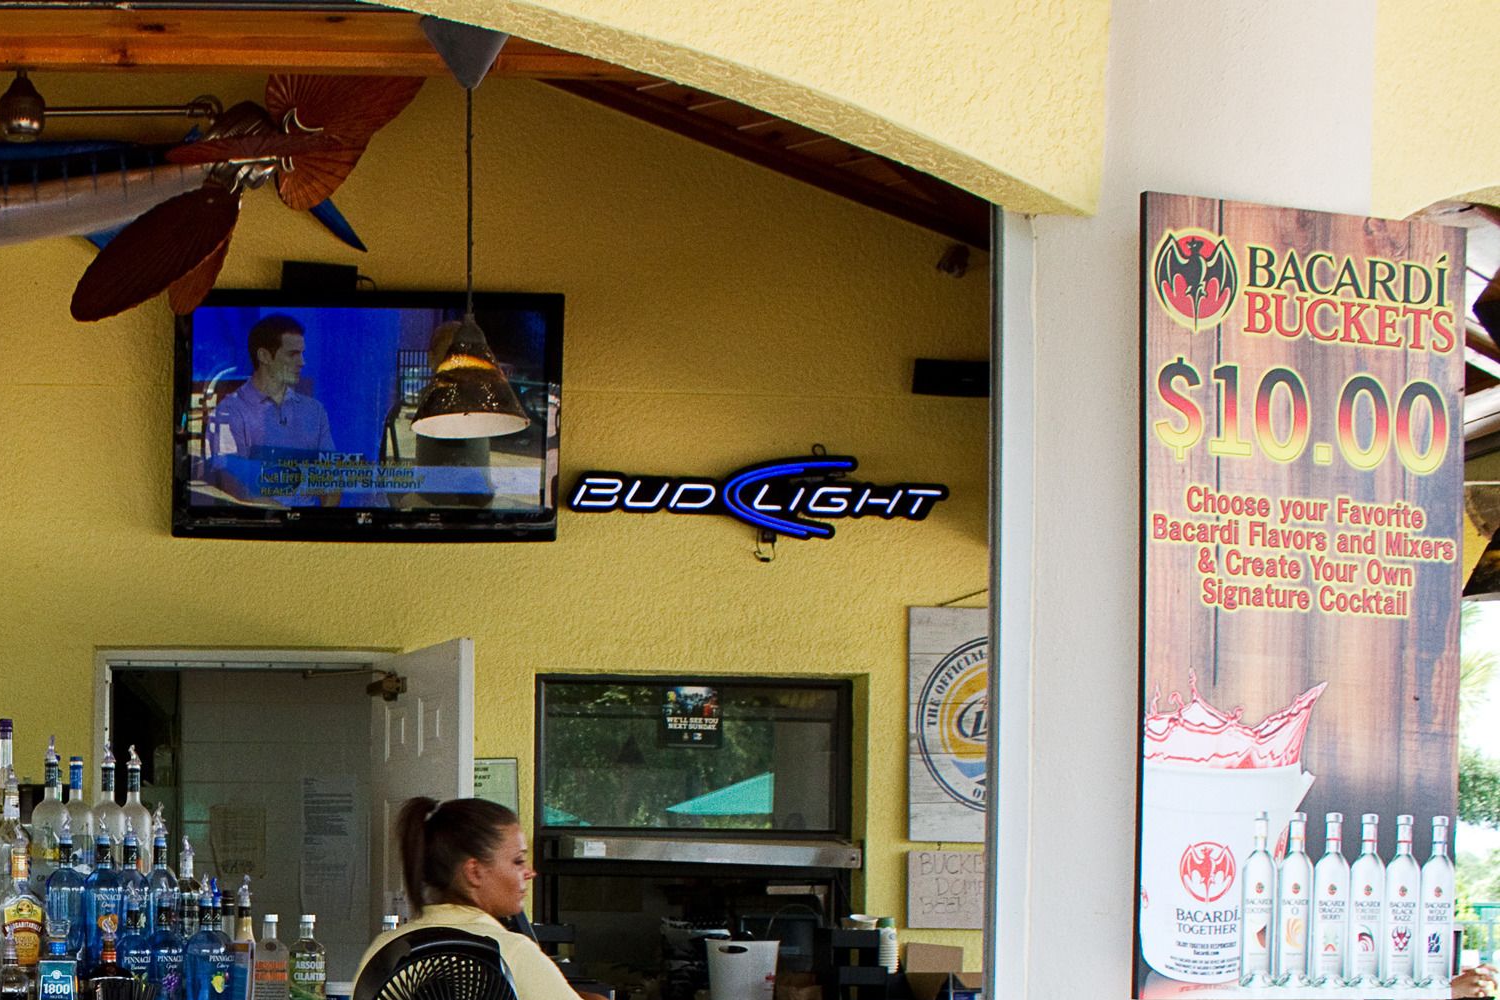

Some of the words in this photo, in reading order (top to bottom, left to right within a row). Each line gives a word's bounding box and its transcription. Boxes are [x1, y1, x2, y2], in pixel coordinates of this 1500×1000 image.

[1246, 246, 1449, 308] BACARDÍ
[1243, 290, 1455, 353] BUCKETS
[1155, 357, 1450, 475] $10.00
[572, 478, 716, 509] BUD
[752, 484, 943, 515] LIGHT
[1186, 485, 1270, 518] Choose
[1279, 498, 1329, 524] your
[1336, 498, 1424, 530] Favorite
[1152, 514, 1240, 545] Bacardi
[1249, 521, 1327, 552] Flavors
[1336, 531, 1376, 555] and
[1385, 531, 1455, 561] Mixers
[1198, 547, 1216, 574] &
[1225, 549, 1301, 579] Create
[1310, 554, 1359, 584] Your
[1366, 558, 1413, 587] Own
[1202, 578, 1311, 610] Signature
[1319, 585, 1408, 616] Cocktail
[926, 697, 941, 728] THE
[1176, 923, 1237, 935] TOGETHER
[43, 983, 71, 995] 1800
